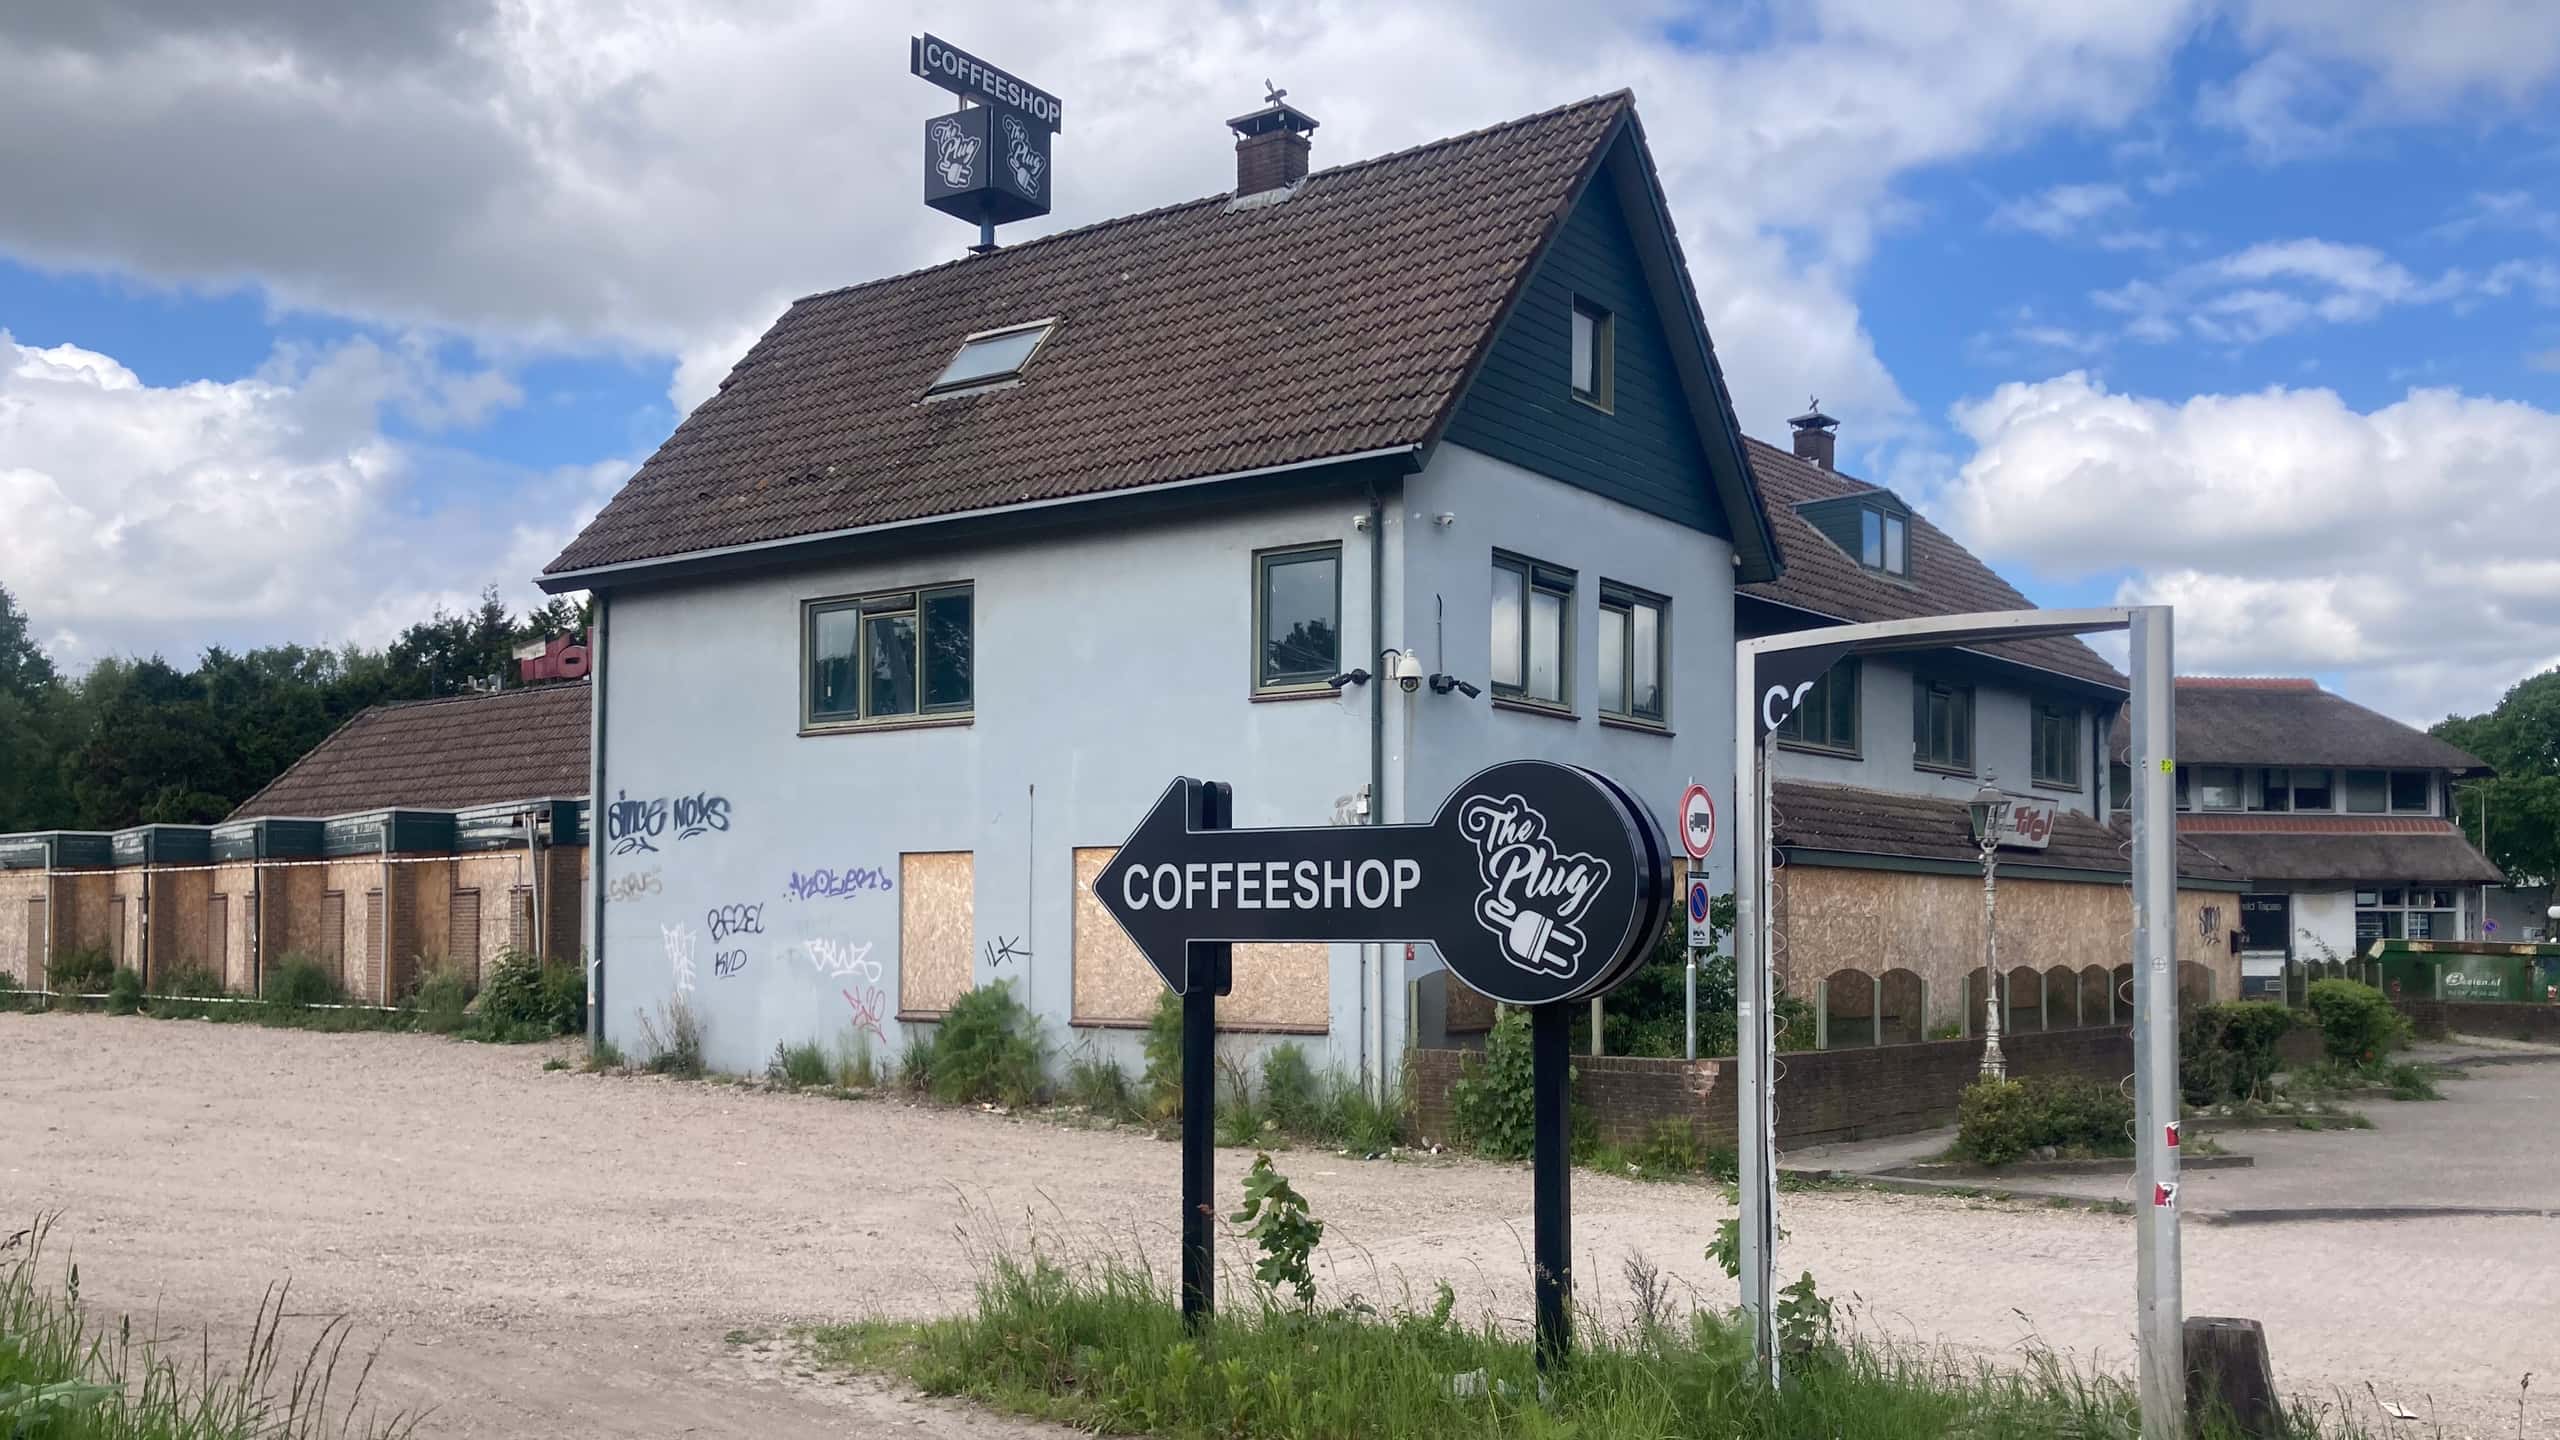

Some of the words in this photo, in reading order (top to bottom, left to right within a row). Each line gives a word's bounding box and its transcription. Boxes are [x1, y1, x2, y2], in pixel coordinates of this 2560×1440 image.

[926, 44, 1060, 123] COFFEESHOP
[934, 124, 957, 143] The
[1005, 119, 1026, 140] The
[941, 137, 979, 165] Plug
[1011, 140, 1043, 175] Plug
[1468, 805, 1536, 853] The
[1122, 858, 1422, 911] COFFEESHOP
[1488, 843, 1601, 917] Plug
